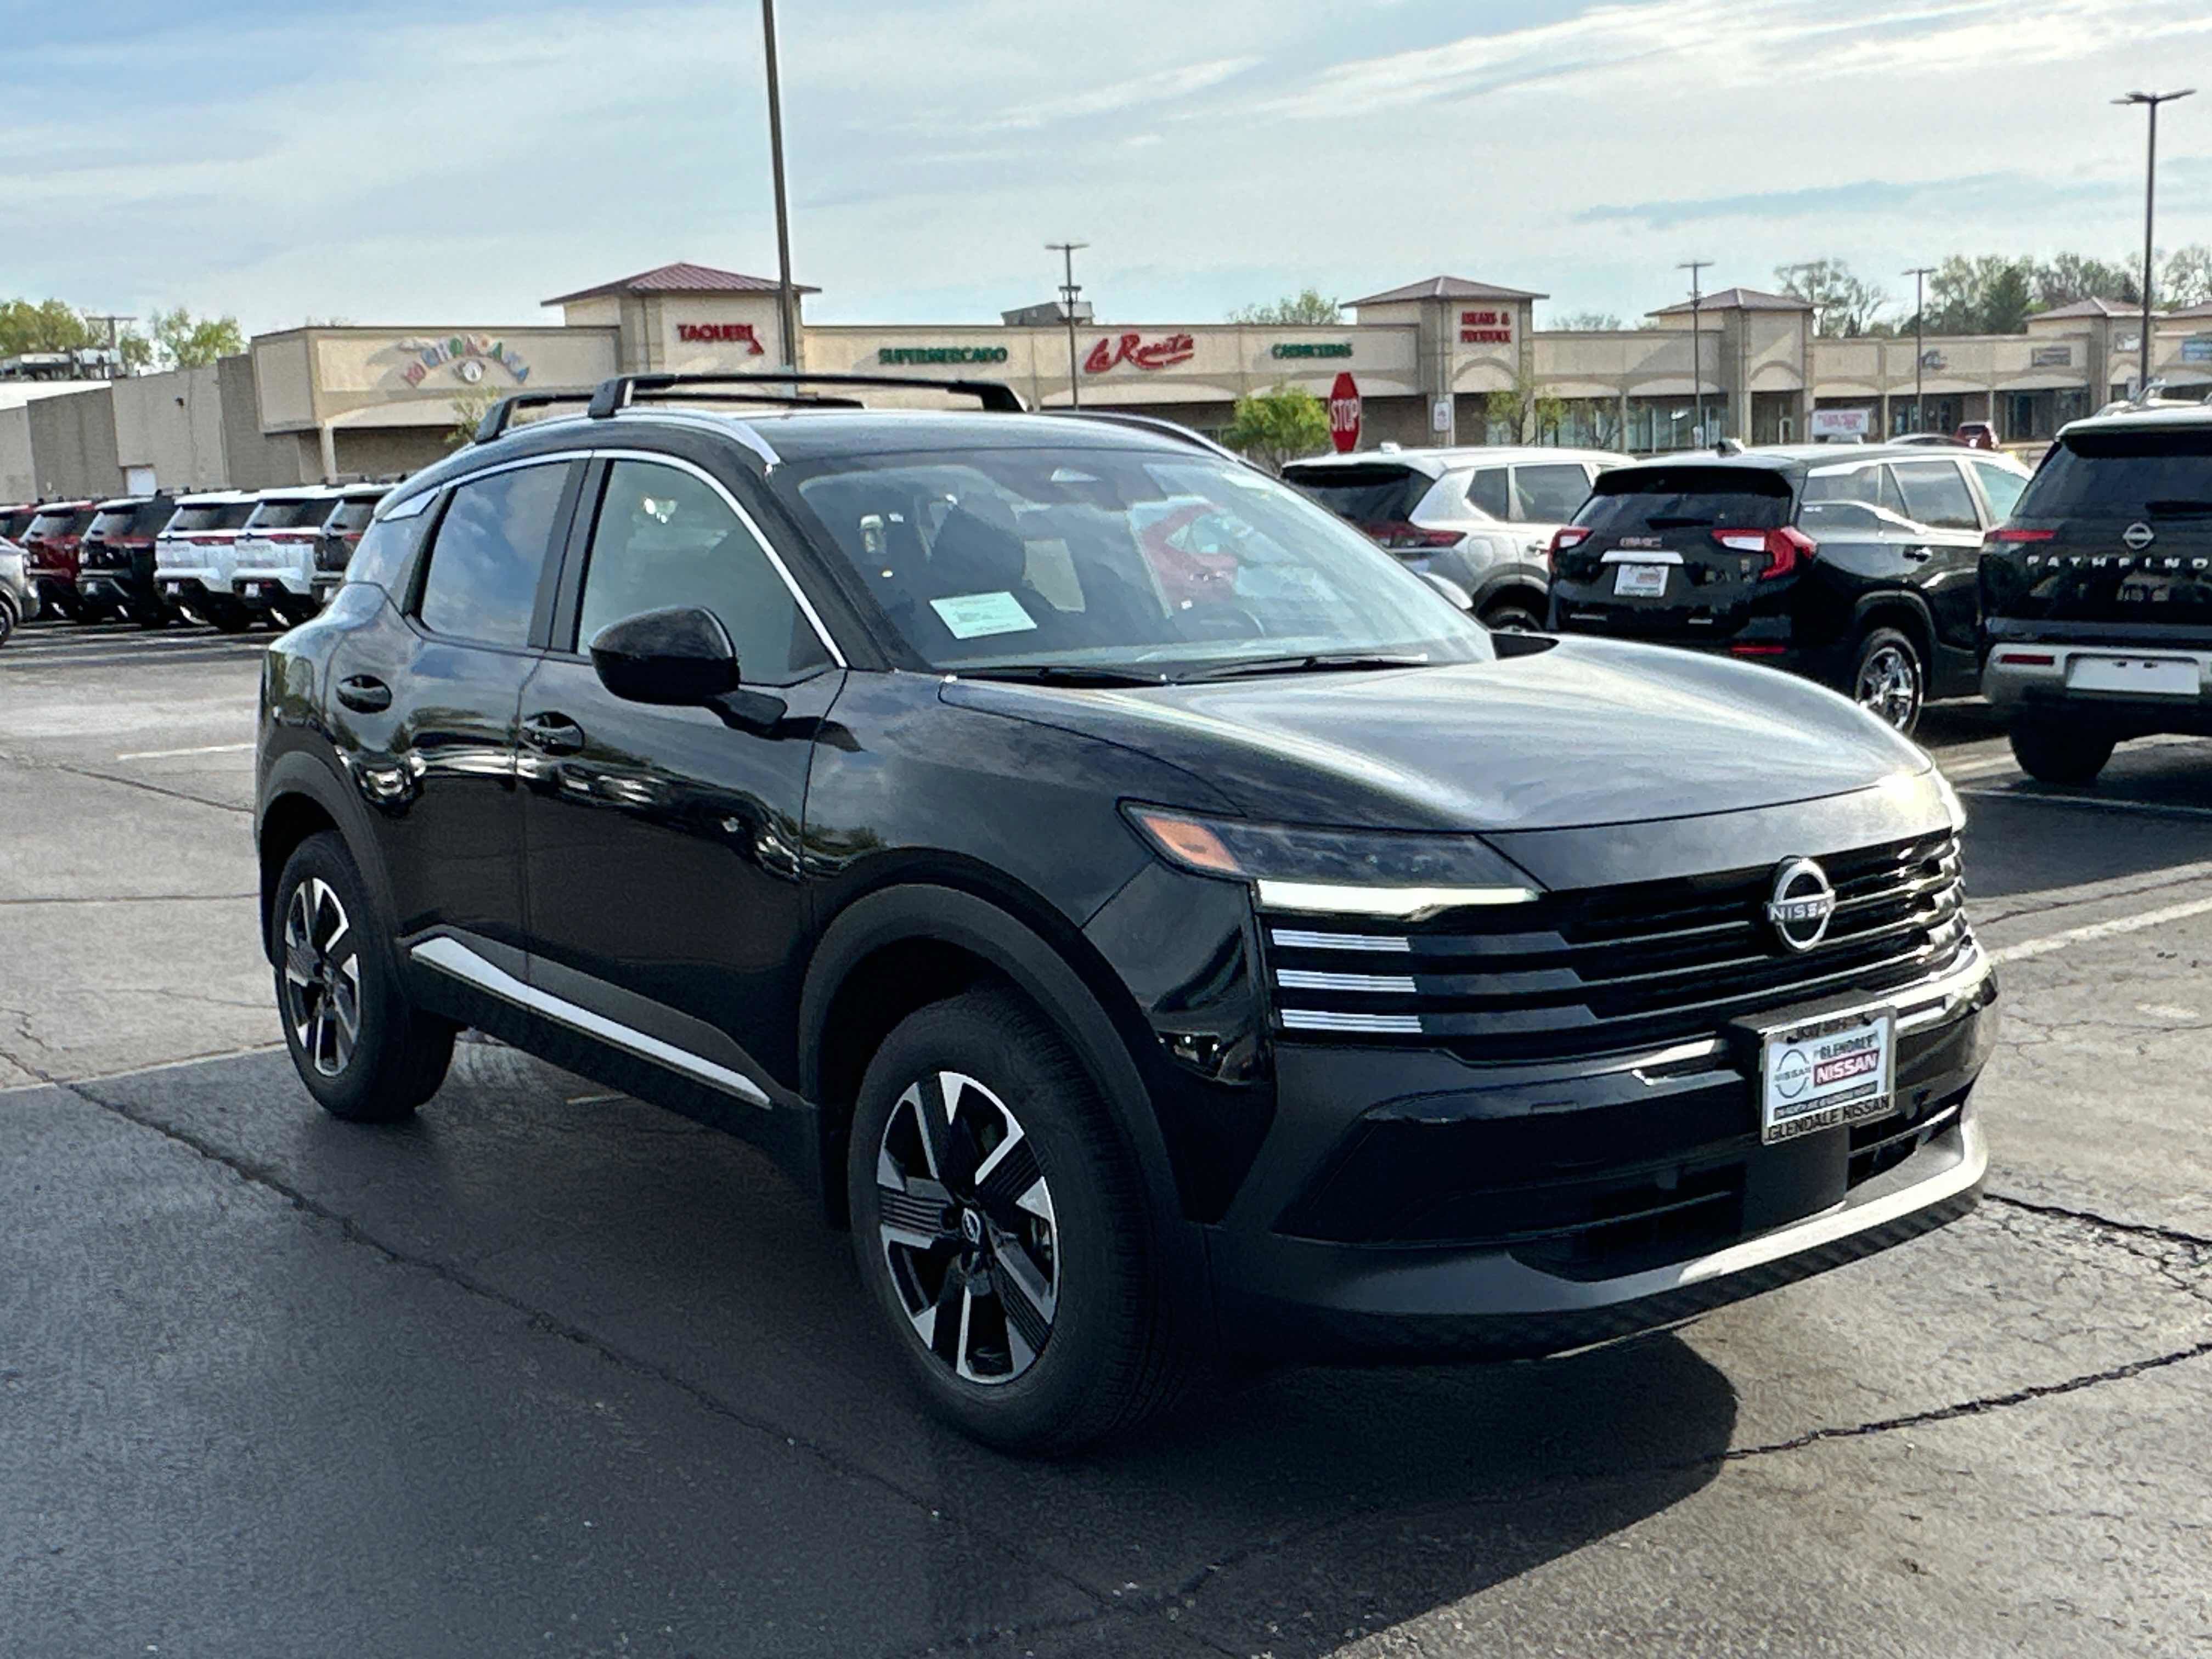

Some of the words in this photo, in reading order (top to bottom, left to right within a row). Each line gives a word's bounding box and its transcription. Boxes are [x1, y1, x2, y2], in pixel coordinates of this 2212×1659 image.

[879, 347, 1008, 365] SUPERMERCADO
[1331, 399, 1358, 432] STOP
[1816, 1052, 1878, 1084] NISSAN
[1768, 1110, 1838, 1141] GLENDALE
[1843, 1096, 1889, 1119] NISSAN
